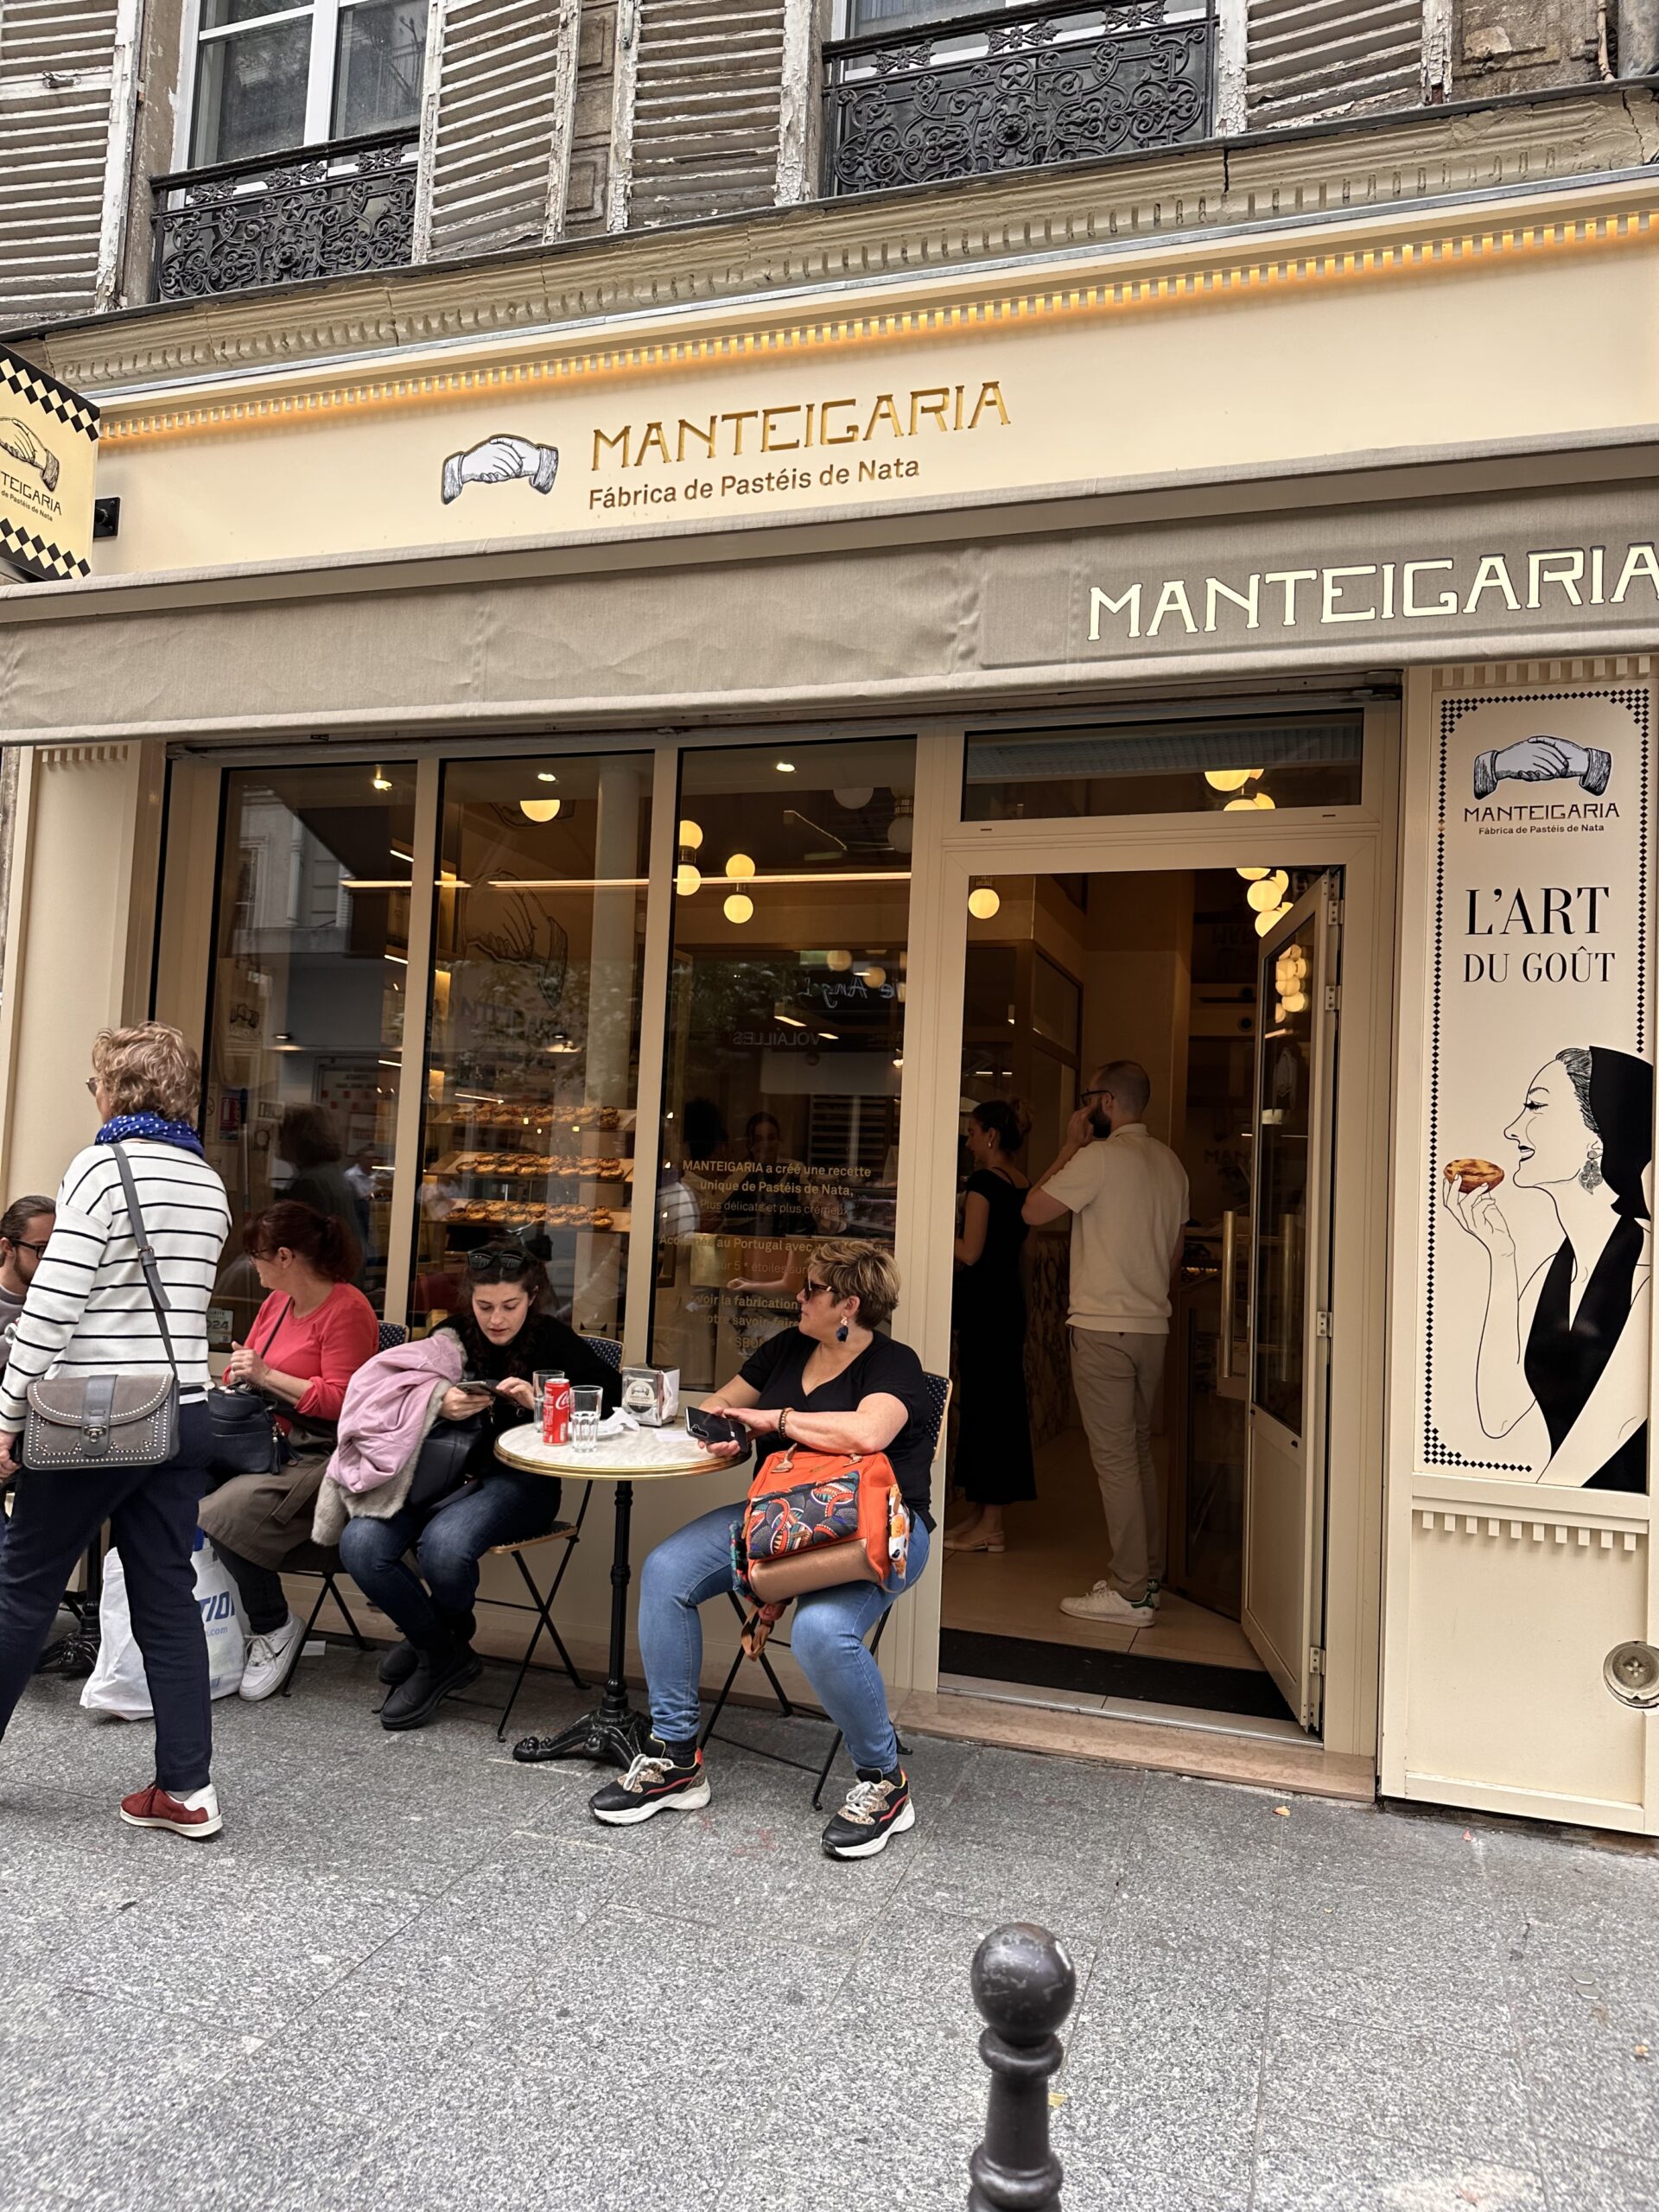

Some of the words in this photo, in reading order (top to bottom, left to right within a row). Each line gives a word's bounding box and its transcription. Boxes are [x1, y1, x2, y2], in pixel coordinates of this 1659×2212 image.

[591, 380, 1012, 472] MANTEIGARIA
[0, 470, 62, 516] TEIGARIA
[588, 484, 677, 511] Fábrica
[683, 478, 713, 501] de
[721, 467, 812, 498] Pastéis
[819, 463, 849, 486] de
[858, 457, 920, 483] Nata
[10, 493, 31, 510] Pastéis
[40, 510, 54, 522] Nata
[1087, 541, 1659, 642] MANTEIGARIA
[1464, 802, 1620, 823] MANTEIGARIA
[1478, 826, 1514, 836] Fábrica
[1516, 826, 1529, 835] de
[1529, 823, 1565, 834] Pastéis
[1567, 824, 1580, 833] de
[1581, 823, 1605, 833] Nata
[1465, 887, 1610, 936] L'ART
[1463, 953, 1510, 982] DU
[1522, 945, 1616, 982] GOÛT
[683, 1160, 764, 1173] MANTEIGARIA
[766, 1165, 772, 1173] a
[775, 1162, 801, 1175] créé
[804, 1166, 825, 1175] une
[828, 1165, 872, 1178] recette
[700, 1179, 739, 1192] unique
[741, 1181, 756, 1192] de
[759, 1181, 801, 1193] Pastéis
[804, 1183, 819, 1195] de
[822, 1184, 854, 1198] Nata,
[700, 1198, 721, 1211] Plus
[766, 1203, 777, 1213] et
[779, 1202, 801, 1215] plus
[717, 1239, 731, 1249] au
[734, 1237, 783, 1253] Portugal
[785, 1242, 812, 1252] avec
[721, 1294, 731, 1306] la
[734, 1295, 798, 1309] fabrication
